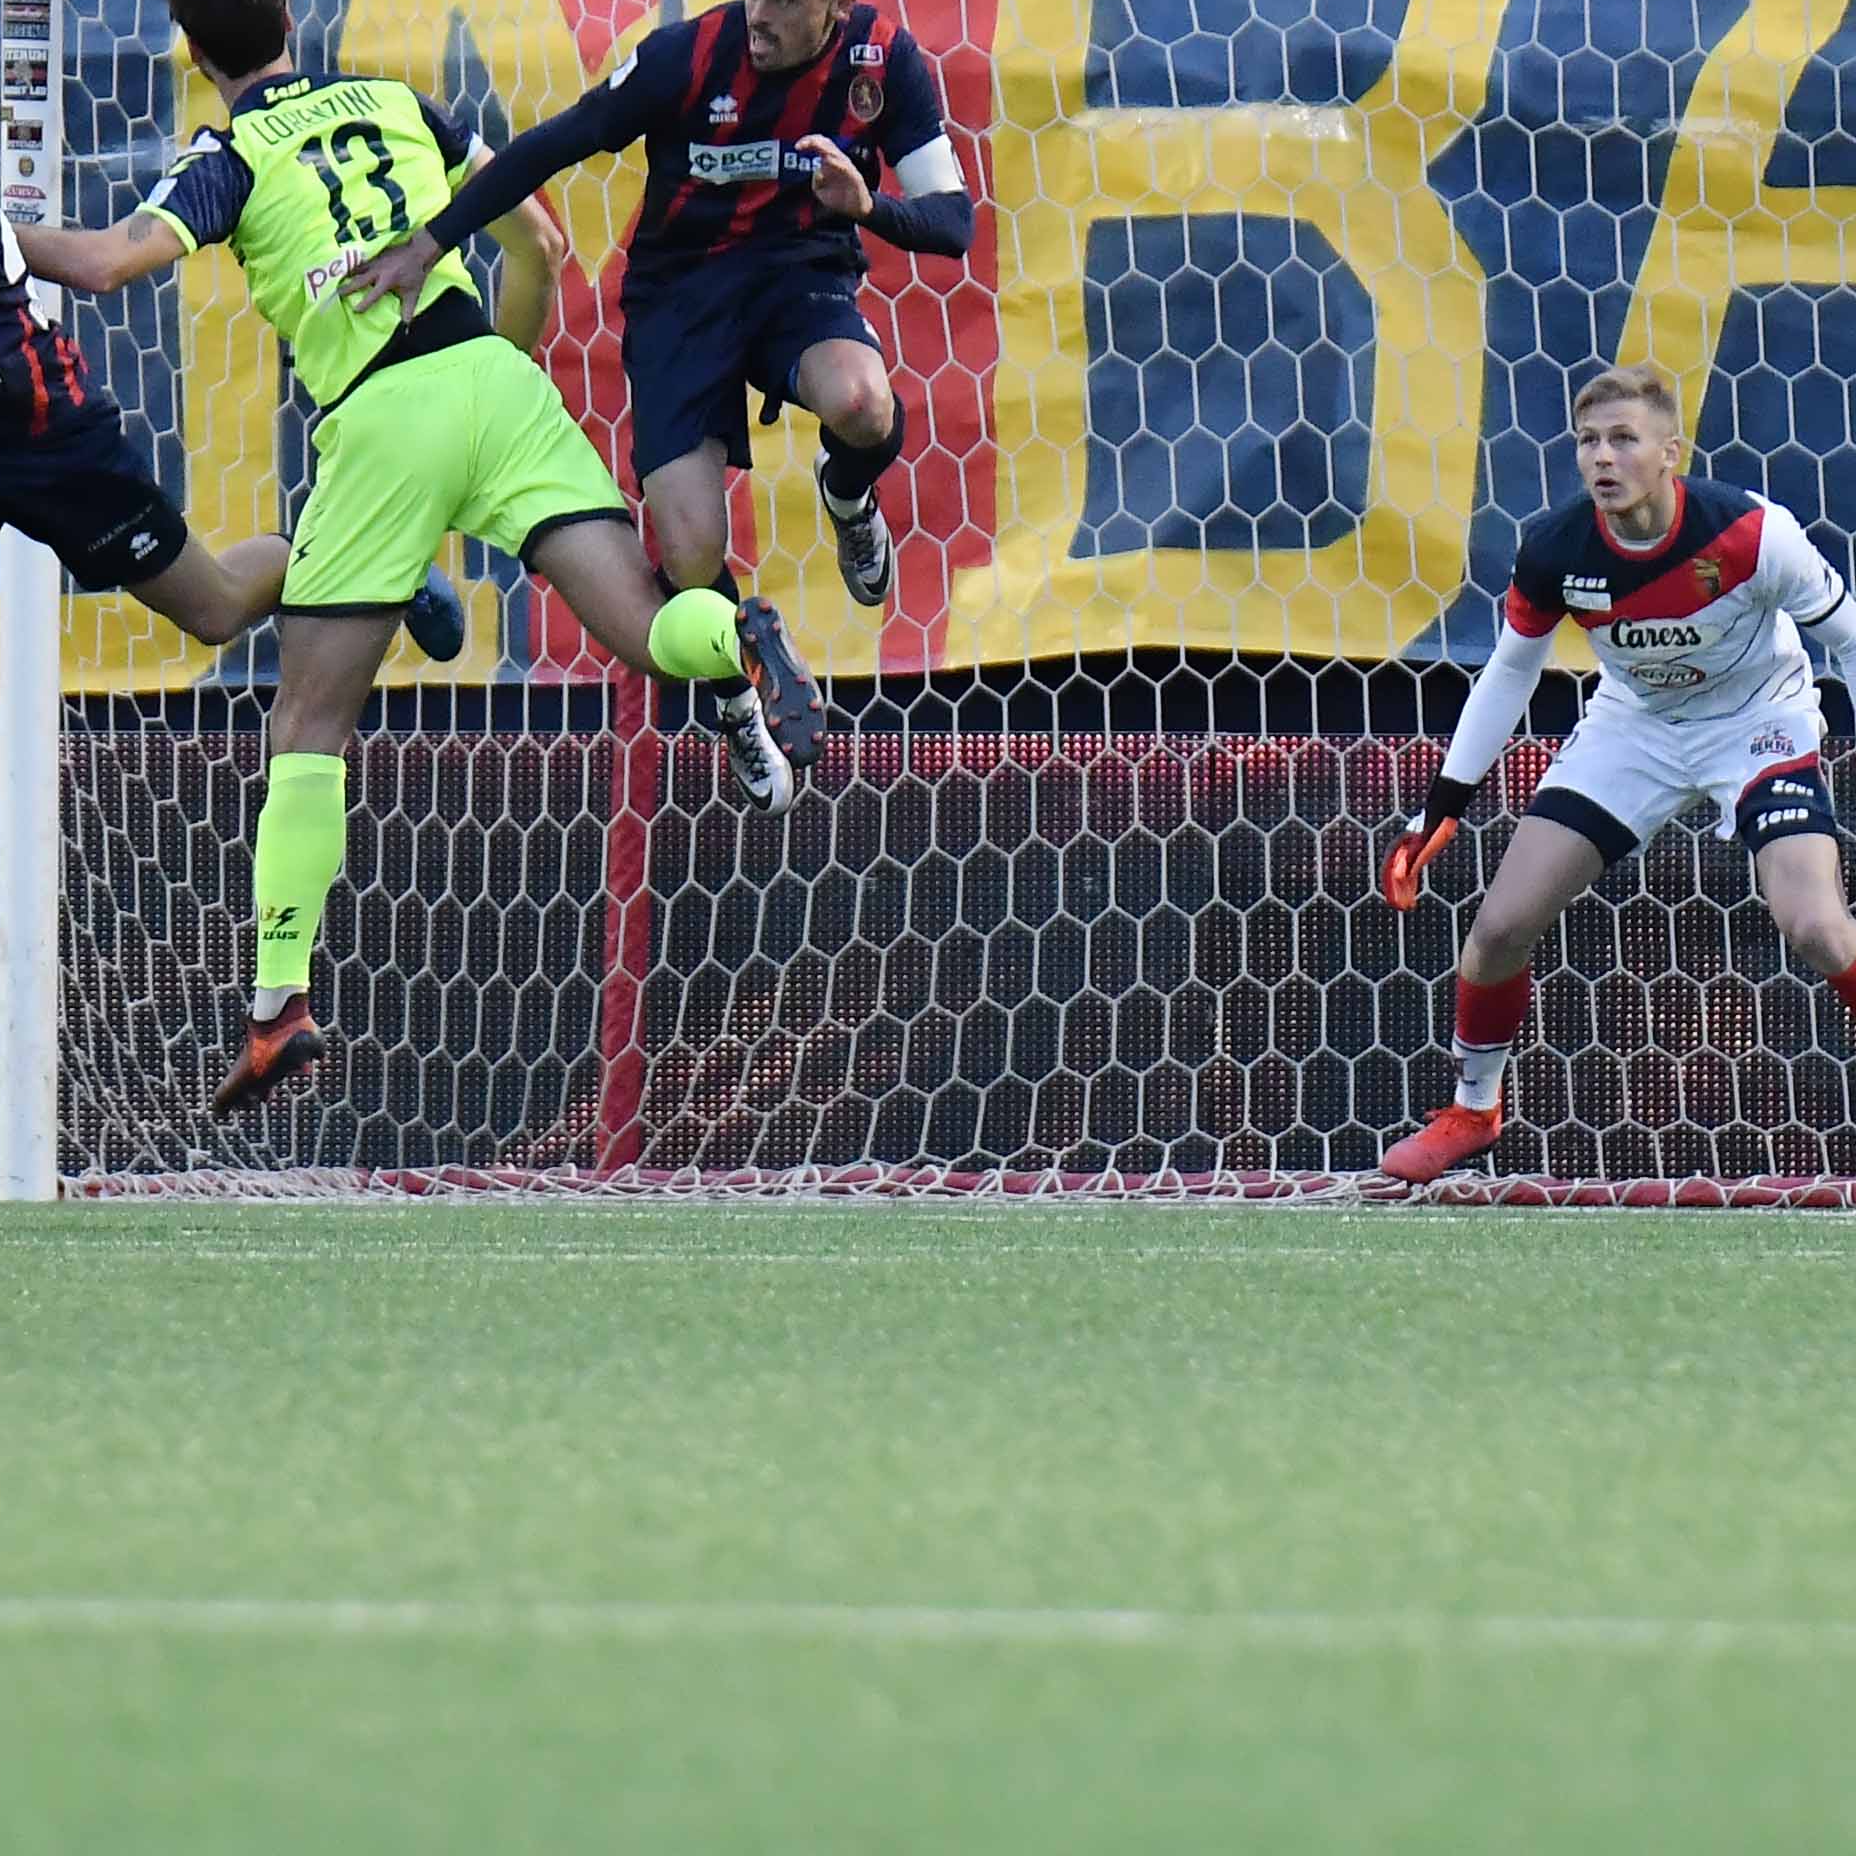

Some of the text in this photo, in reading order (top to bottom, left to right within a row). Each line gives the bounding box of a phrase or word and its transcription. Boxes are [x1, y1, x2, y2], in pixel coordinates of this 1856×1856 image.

[249, 83, 382, 145] LORENZINI
[721, 147, 773, 166] BCC
[784, 152, 823, 171] Bas
[296, 118, 410, 248] 13
[306, 249, 367, 299] pell
[1562, 574, 1607, 590] Zeus
[1610, 618, 1702, 649] Caress
[1747, 807, 1809, 832] Zeus
